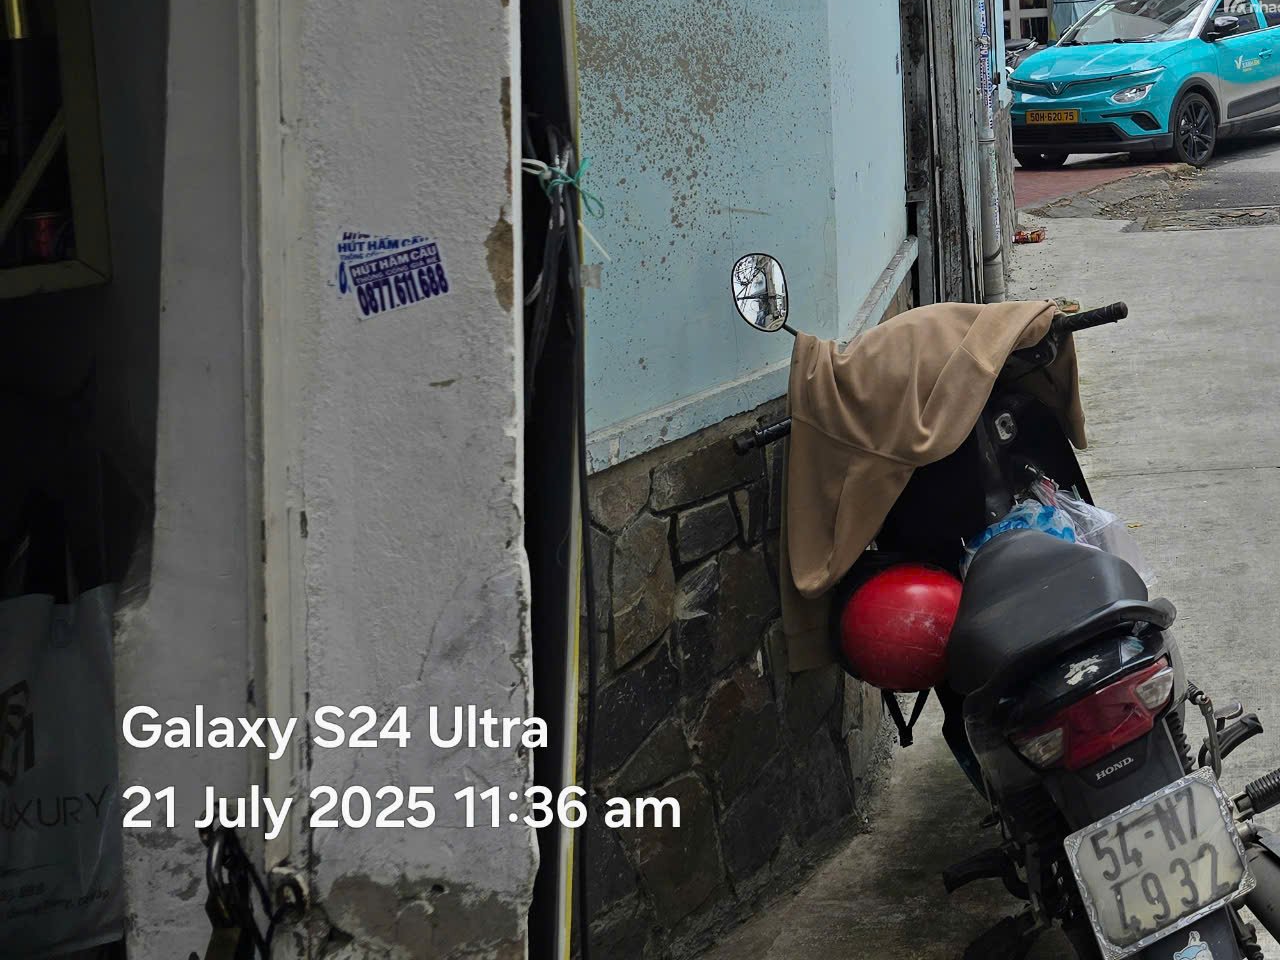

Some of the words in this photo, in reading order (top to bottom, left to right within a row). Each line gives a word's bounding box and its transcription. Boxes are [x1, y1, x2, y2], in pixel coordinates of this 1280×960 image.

[351, 261, 379, 278] HÚT
[380, 251, 409, 269] HẦM
[410, 243, 438, 260] CẦU
[357, 263, 449, 316] 0877.611.688
[1096, 756, 1135, 781] HOND
